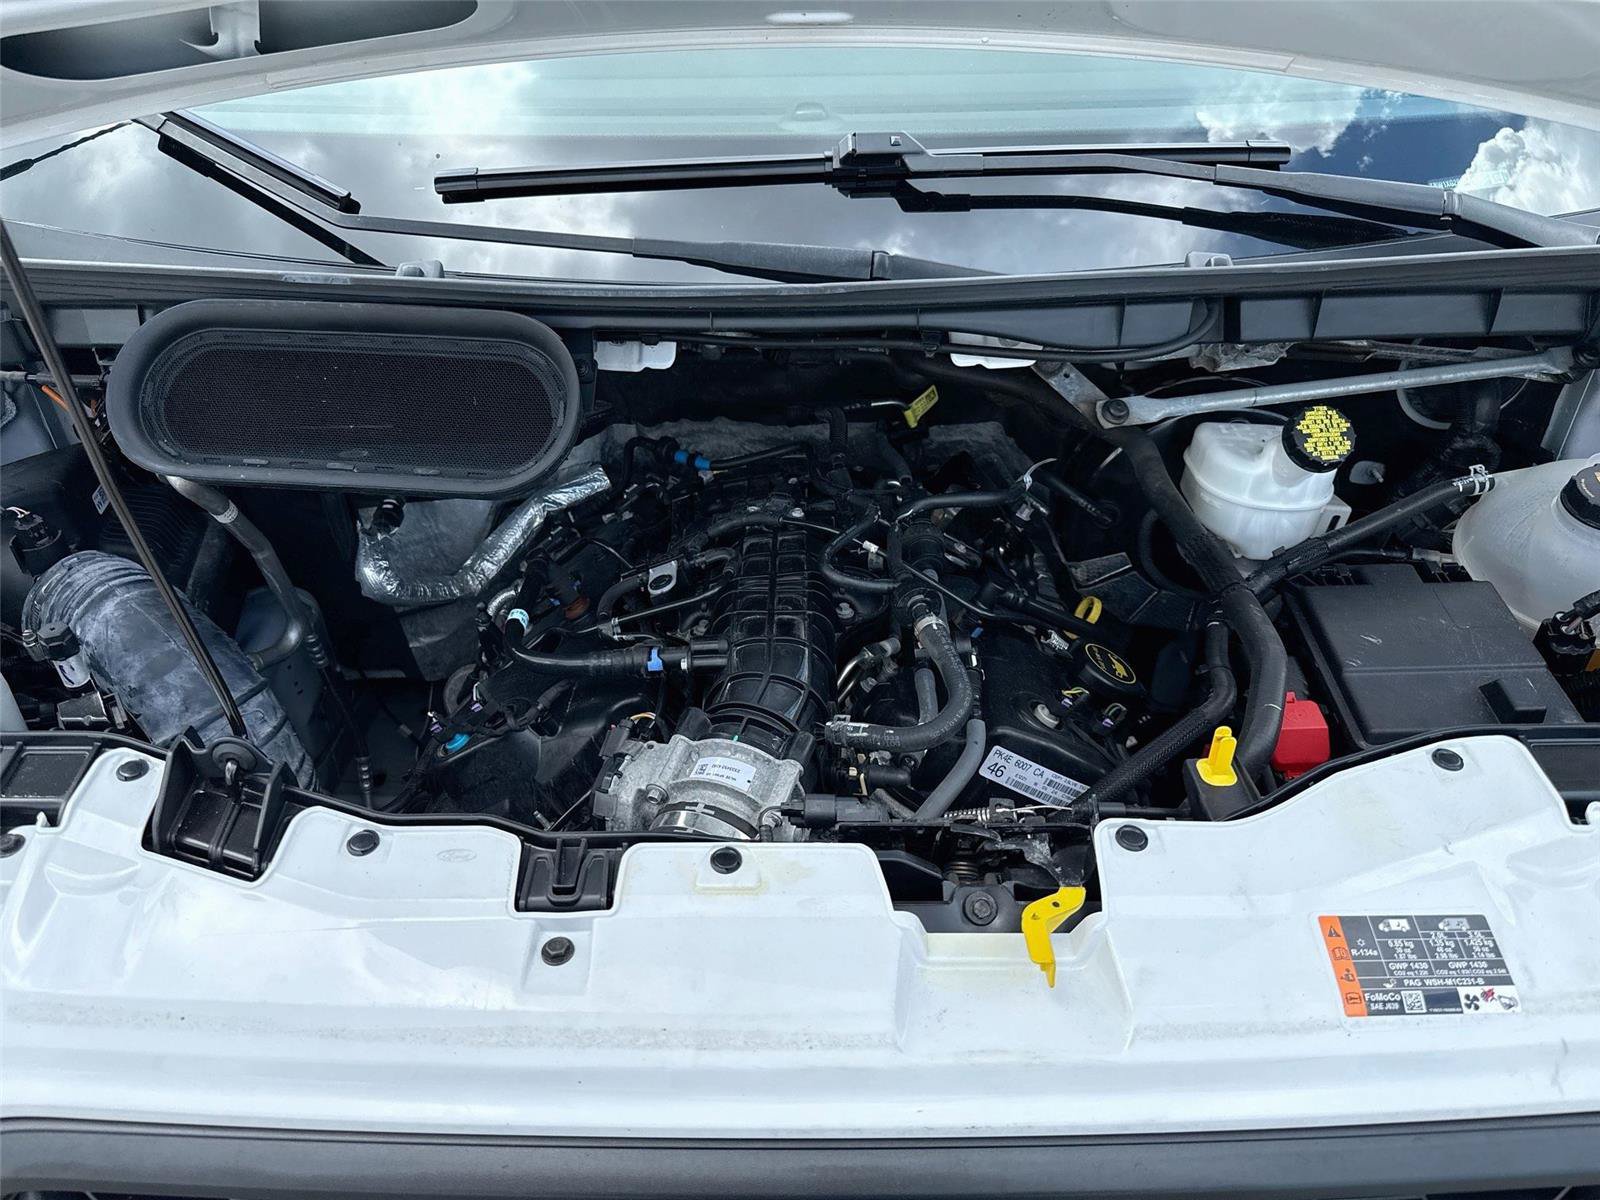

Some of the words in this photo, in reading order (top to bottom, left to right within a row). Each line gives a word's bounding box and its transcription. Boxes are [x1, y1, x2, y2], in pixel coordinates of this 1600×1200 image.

[993, 749, 1014, 764] PK4E
[1014, 759, 1032, 773] 6007
[1033, 767, 1045, 779] CA
[987, 762, 1006, 778] 46
[1403, 940, 1414, 949] kg
[1429, 939, 1444, 947] 1.35
[1445, 939, 1455, 948] kg
[1483, 939, 1494, 948] kg
[1351, 948, 1378, 956] R-134a
[1388, 962, 1408, 970] GWP
[1409, 962, 1429, 970] 1430
[1448, 961, 1467, 969] GWP
[1403, 978, 1422, 986] PAG
[1423, 977, 1485, 986] WSH-M1C231-B
[1364, 992, 1401, 1001] FoMoCo
[1369, 1002, 1383, 1010] SAE
